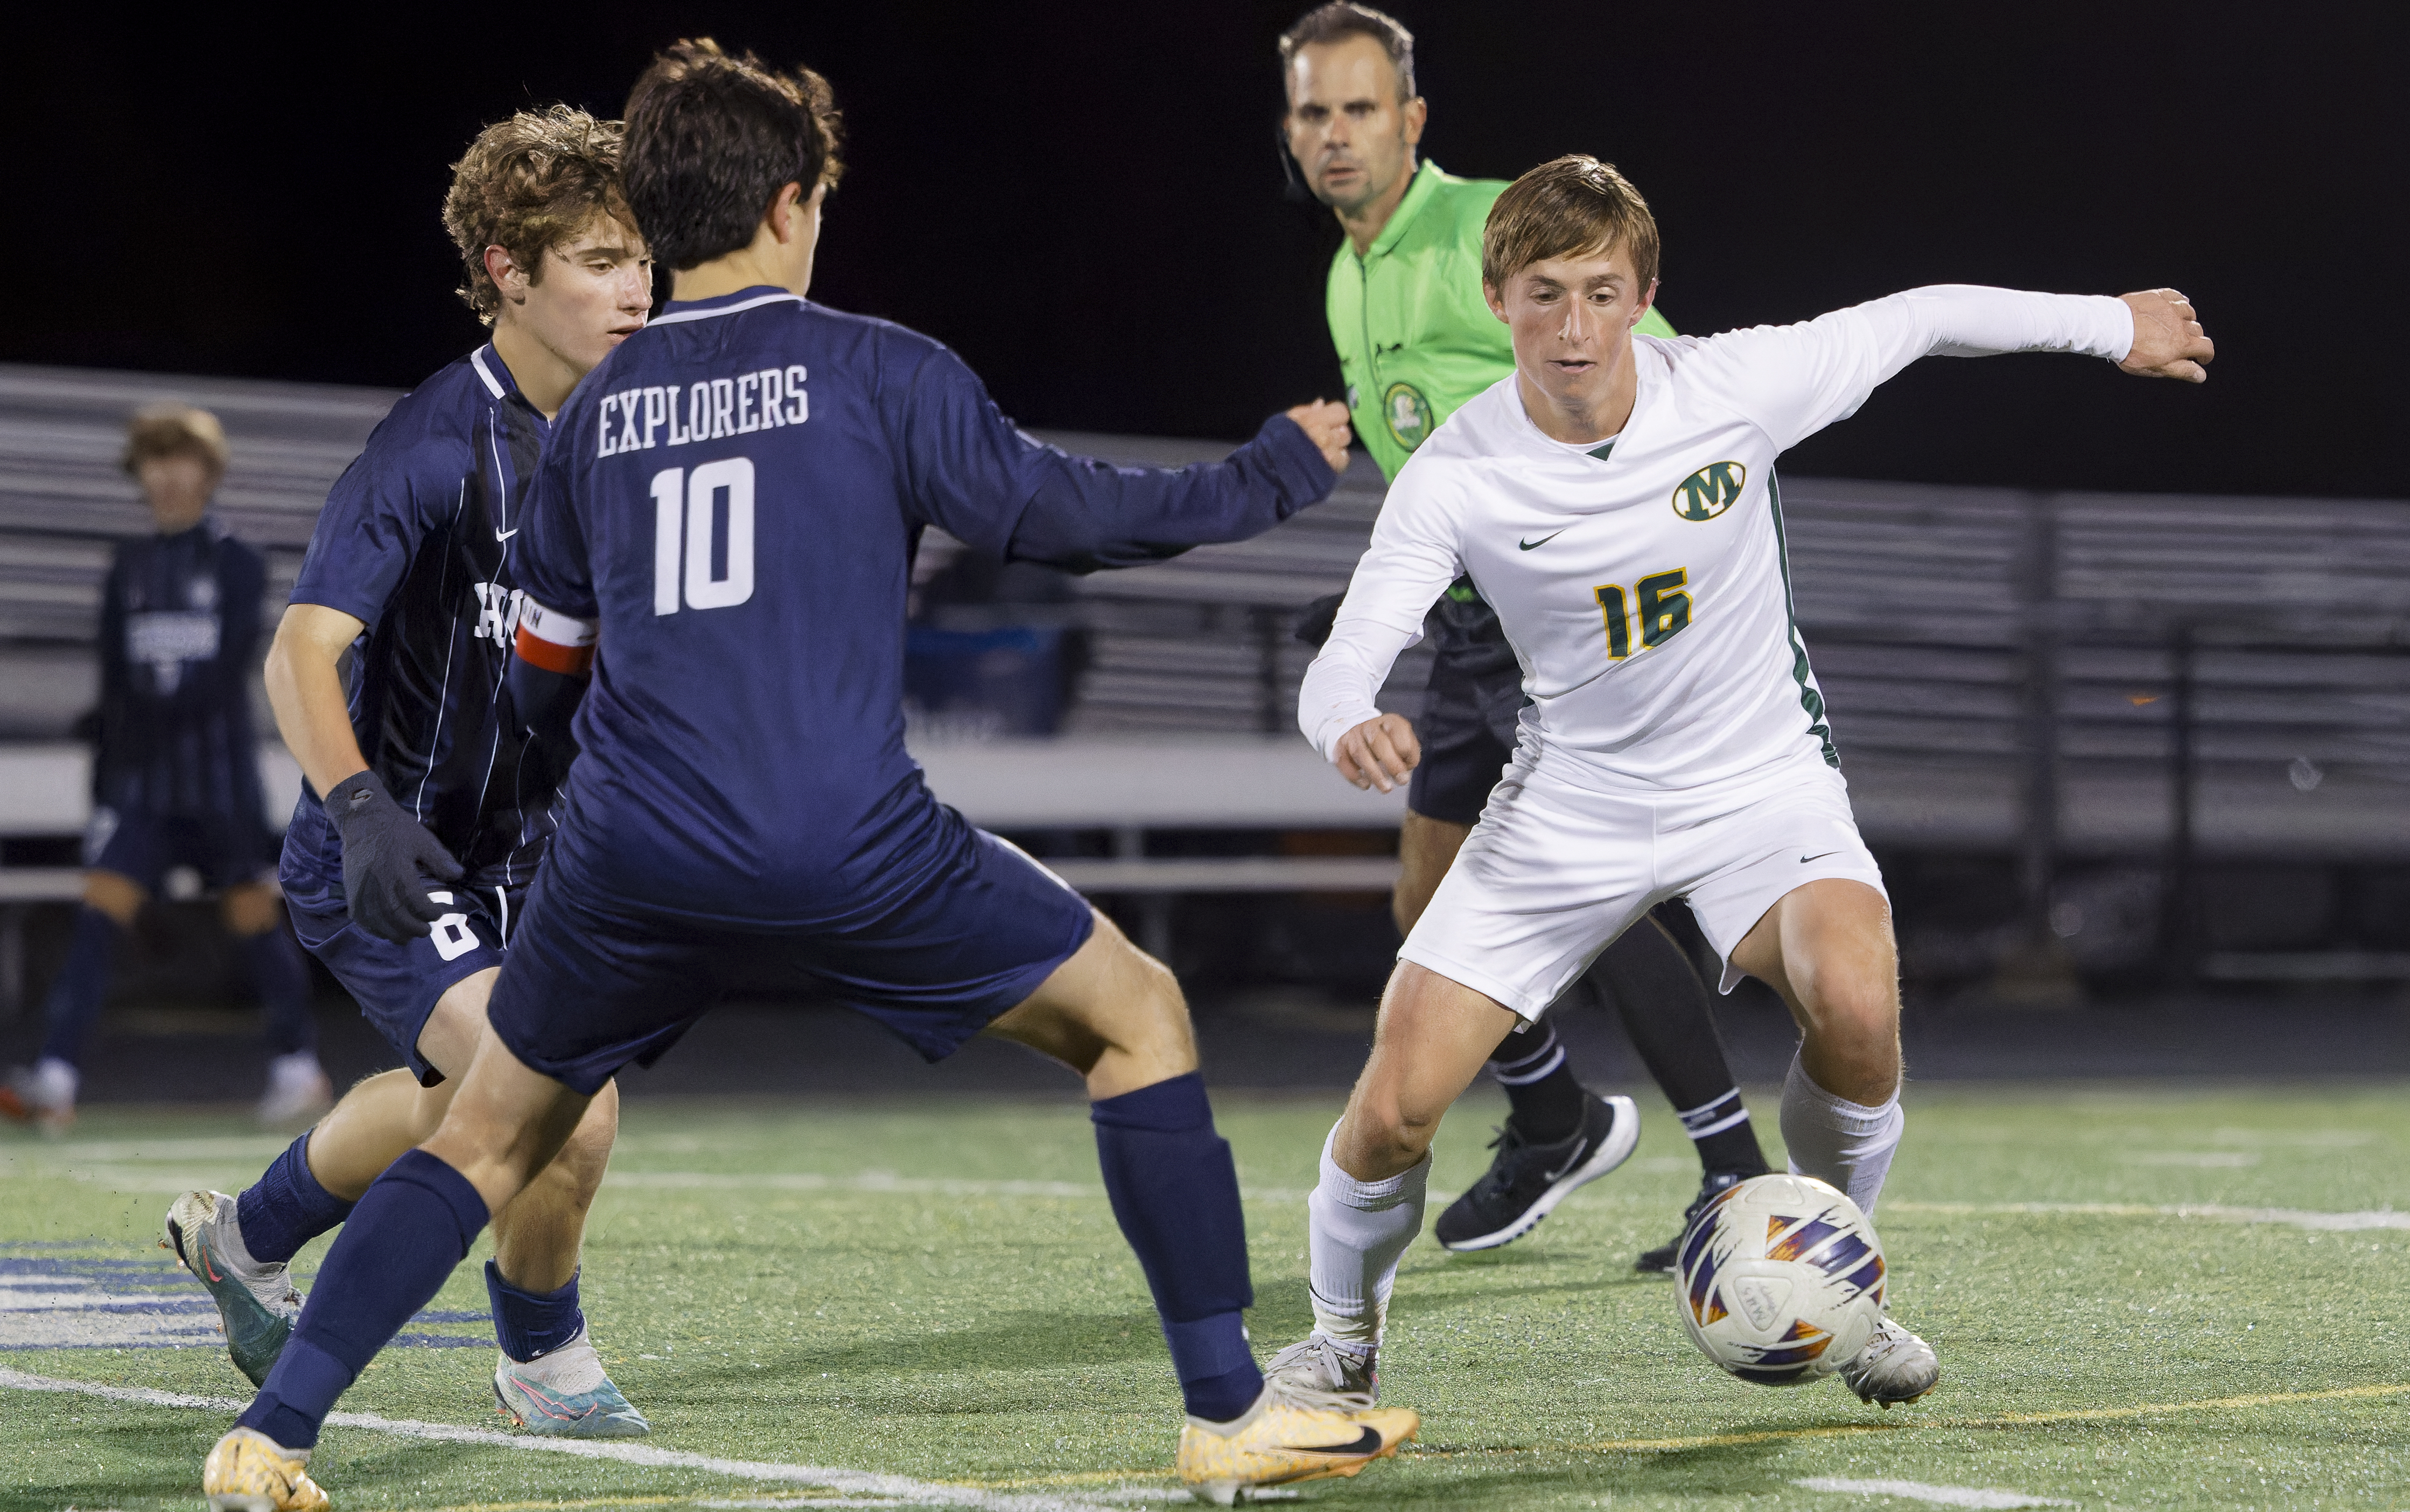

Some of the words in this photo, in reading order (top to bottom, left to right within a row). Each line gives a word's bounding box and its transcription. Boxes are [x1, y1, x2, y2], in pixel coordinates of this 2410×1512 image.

[598, 365, 809, 458] EXPLORERS
[650, 457, 755, 616] 10
[1675, 460, 1745, 522] M
[1593, 566, 1693, 661] 16
